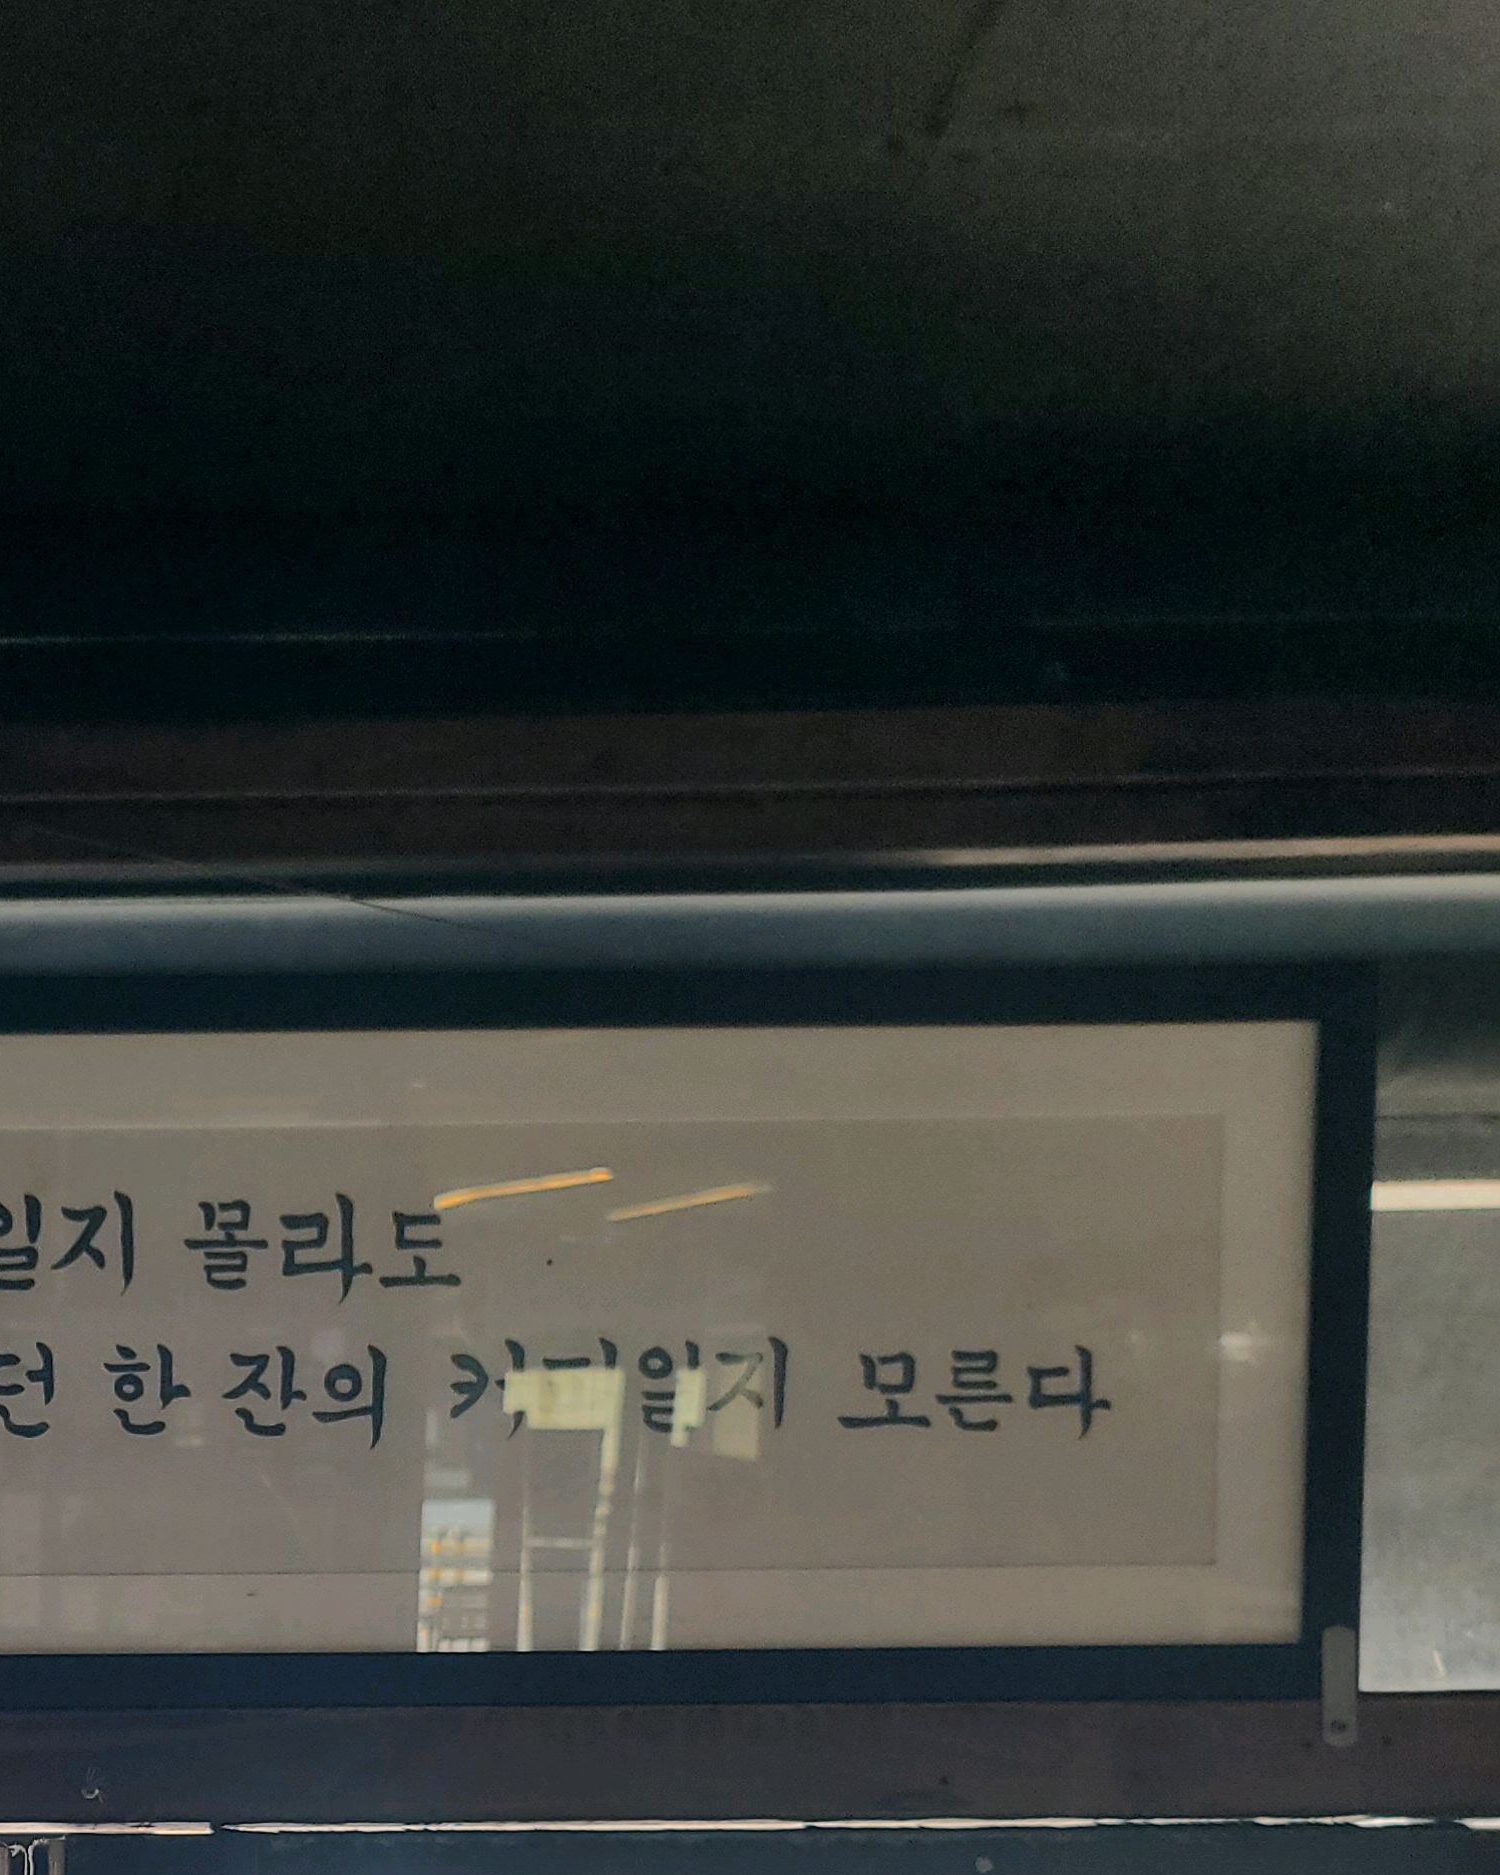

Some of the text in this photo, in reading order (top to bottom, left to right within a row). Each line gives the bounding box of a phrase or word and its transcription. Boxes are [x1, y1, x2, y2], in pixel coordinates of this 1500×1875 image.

[184, 1191, 462, 1303] 몰라도
[103, 1343, 191, 1436] 한
[221, 1343, 387, 1450] 잔의
[838, 1344, 1112, 1440] 모른다
